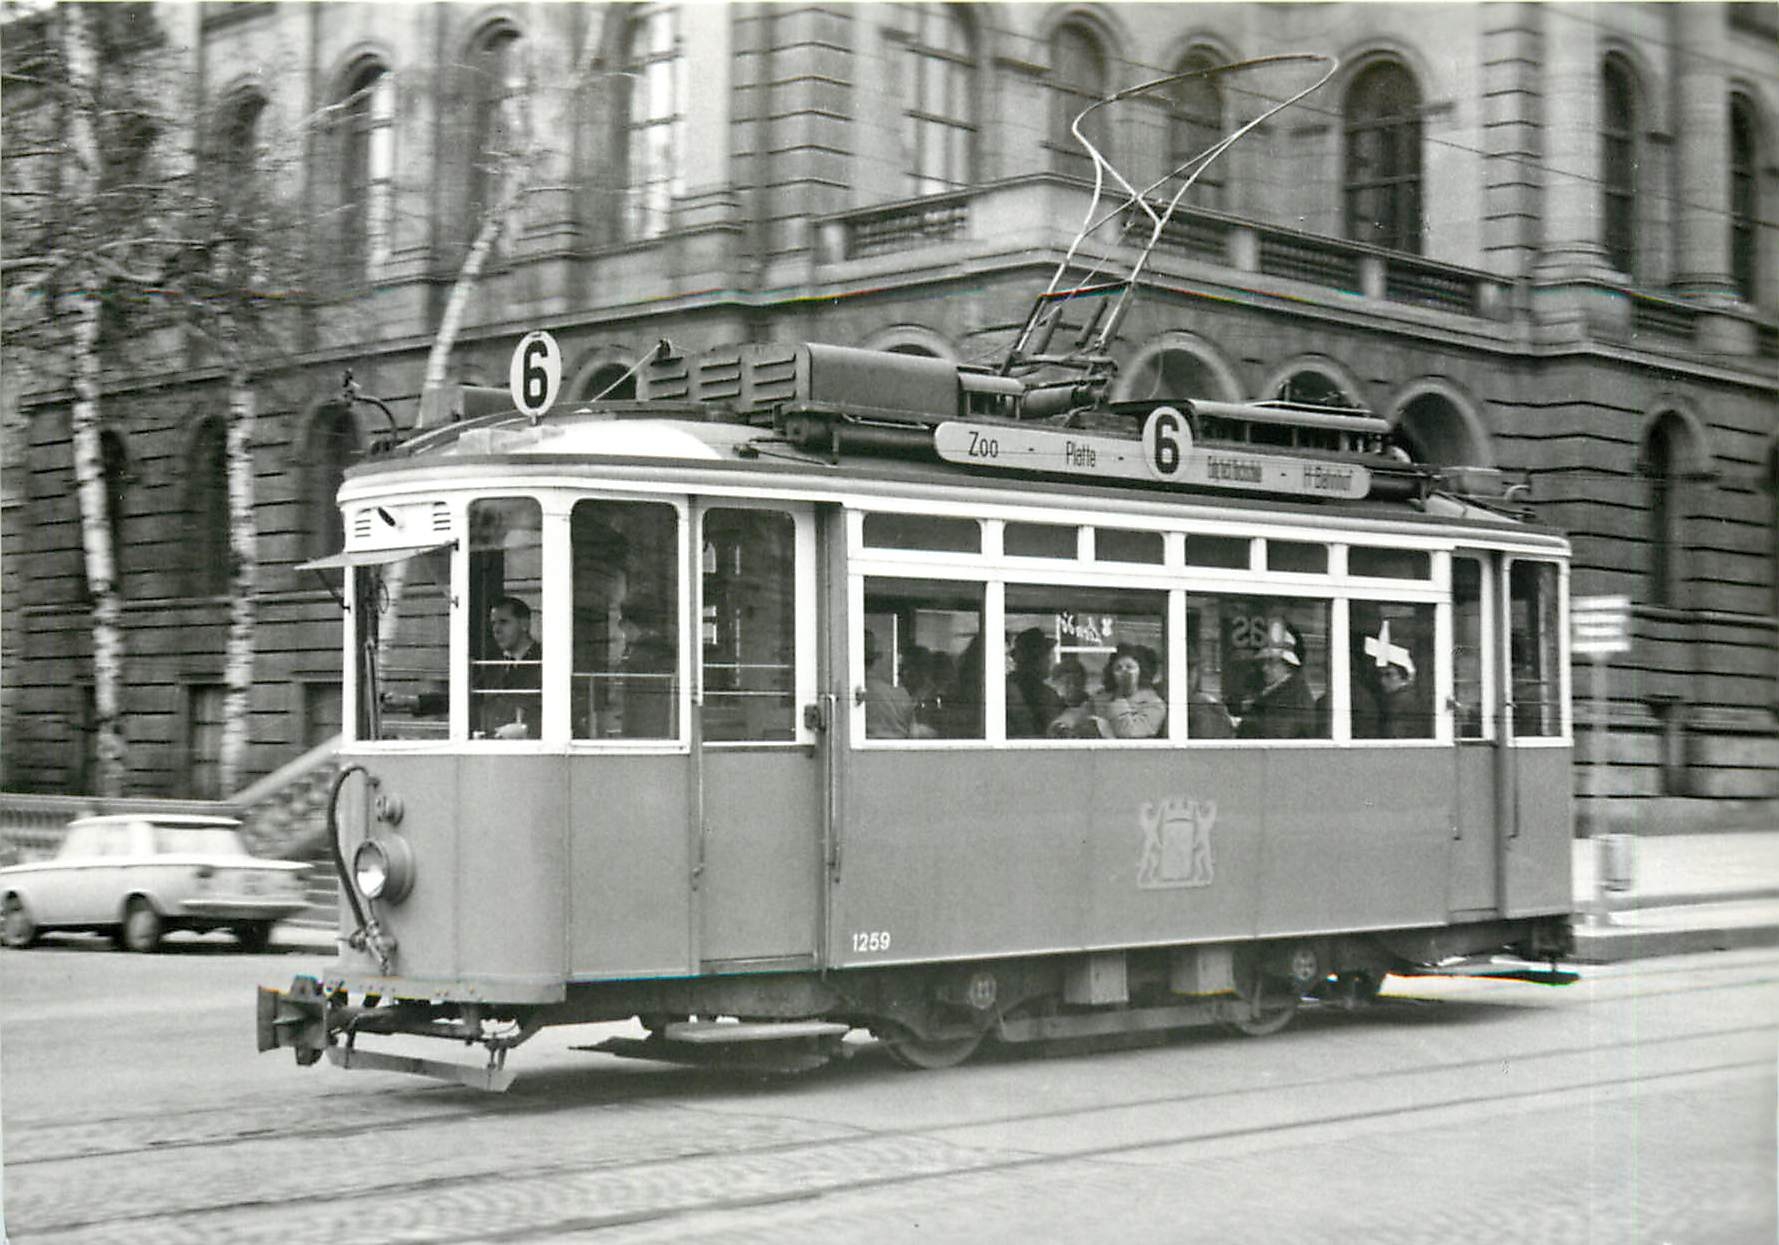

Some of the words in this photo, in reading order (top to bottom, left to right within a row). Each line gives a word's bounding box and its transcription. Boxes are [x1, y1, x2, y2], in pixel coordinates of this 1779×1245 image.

[523, 340, 548, 409] 6
[968, 431, 999, 458] Zoo
[1066, 441, 1097, 468] Platte
[1154, 413, 1180, 474] 6
[852, 931, 891, 952] 1259
